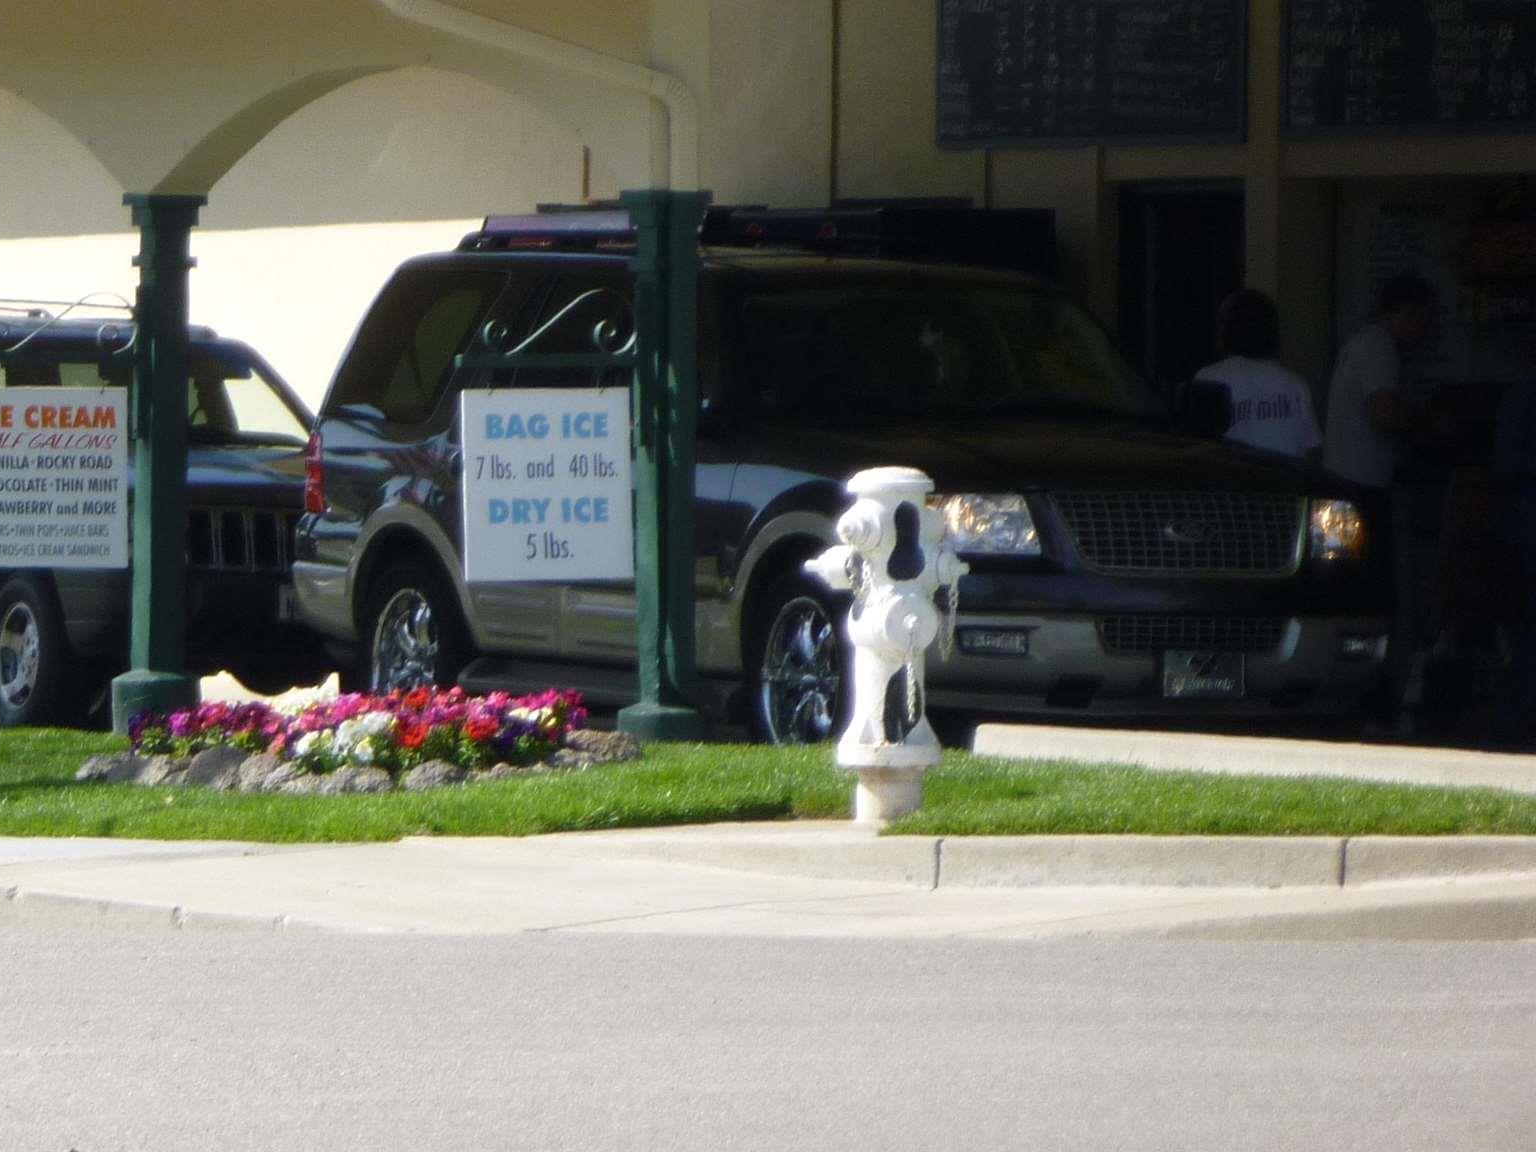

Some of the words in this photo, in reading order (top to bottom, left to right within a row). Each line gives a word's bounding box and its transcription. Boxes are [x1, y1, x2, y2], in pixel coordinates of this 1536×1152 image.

[24, 405, 117, 429] CREAM
[485, 414, 550, 439] BAG
[561, 412, 609, 439] ICE
[28, 432, 118, 449] GALLONS
[80, 455, 113, 470] ROAD
[476, 456, 485, 479] 7
[491, 453, 516, 479] lbs.
[527, 453, 554, 478] and
[569, 454, 588, 478] 40
[593, 453, 618, 478] lbs.
[88, 478, 119, 493] MINT
[56, 501, 79, 515] and
[82, 501, 117, 515] MORE
[488, 499, 551, 524] DRY
[561, 497, 609, 524] ICE
[526, 533, 537, 559] 5
[543, 530, 575, 559] lbs.
